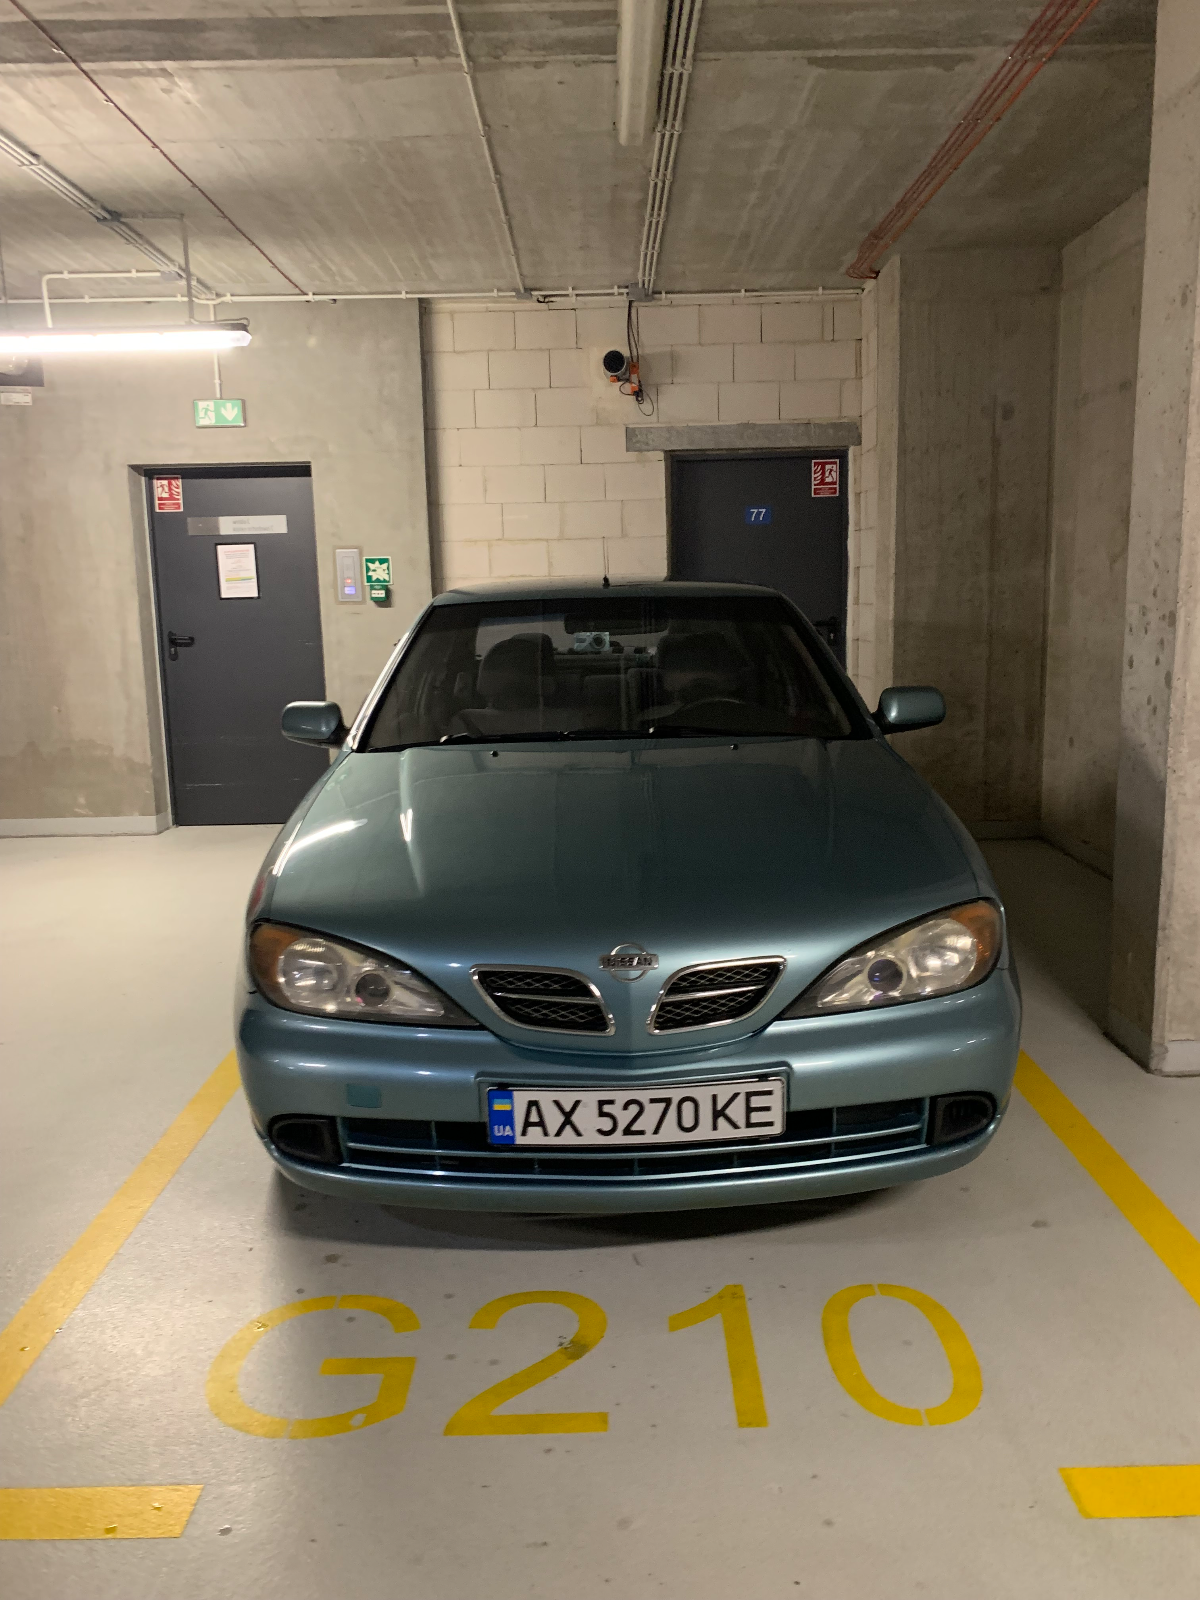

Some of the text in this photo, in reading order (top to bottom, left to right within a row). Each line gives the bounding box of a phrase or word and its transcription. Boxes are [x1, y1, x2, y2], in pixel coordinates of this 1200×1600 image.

[750, 509, 766, 521] 77
[601, 956, 653, 968] NISSAN
[521, 1089, 774, 1137] AX 5270 KE
[494, 1125, 513, 1137] UA
[205, 1283, 984, 1440] G210
